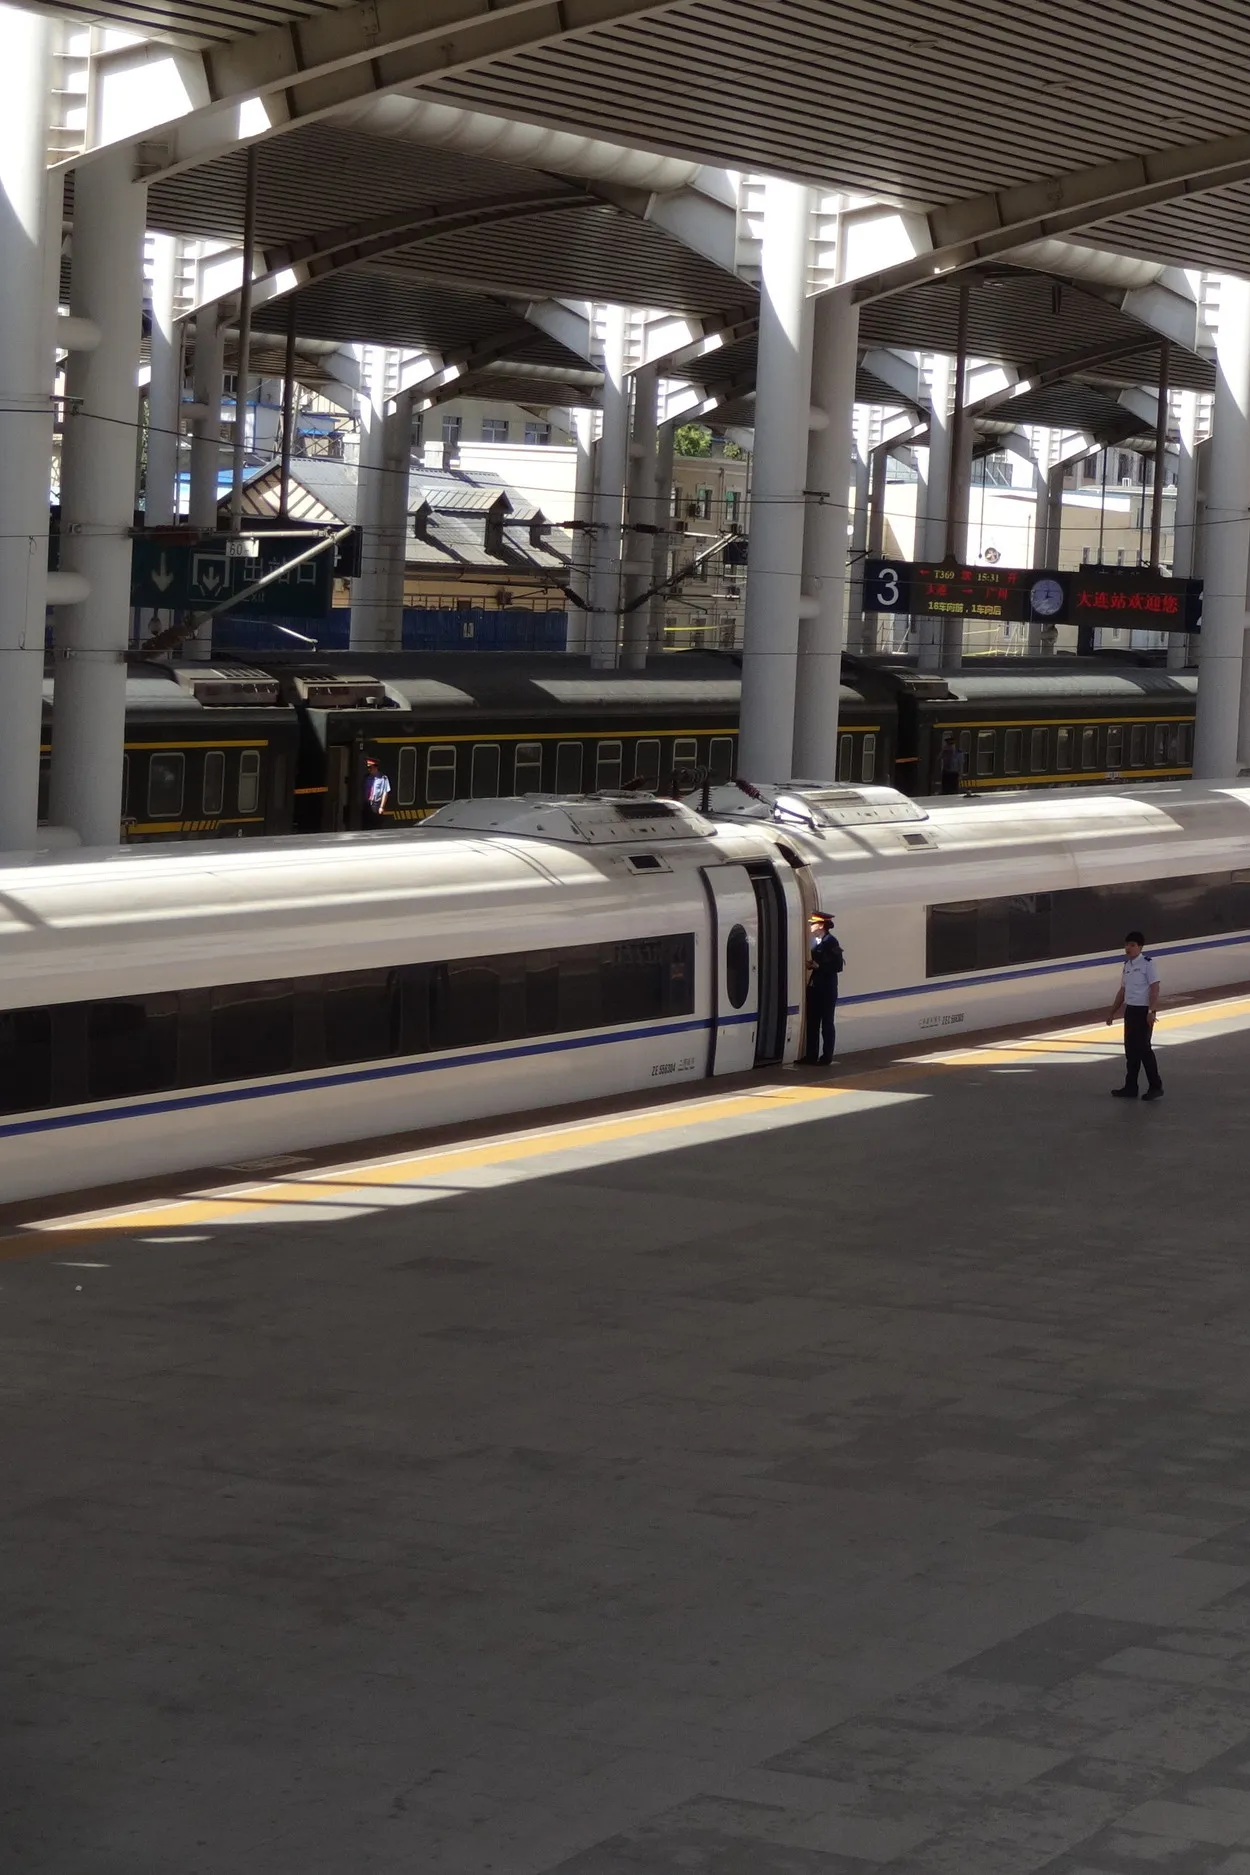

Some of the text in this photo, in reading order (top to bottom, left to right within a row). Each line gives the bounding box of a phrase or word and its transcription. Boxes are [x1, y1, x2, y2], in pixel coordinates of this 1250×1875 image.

[876, 567, 899, 606] 3
[933, 569, 955, 580] T369
[977, 572, 1000, 583] 15:31
[1076, 590, 1180, 614] 大连站欢迎您
